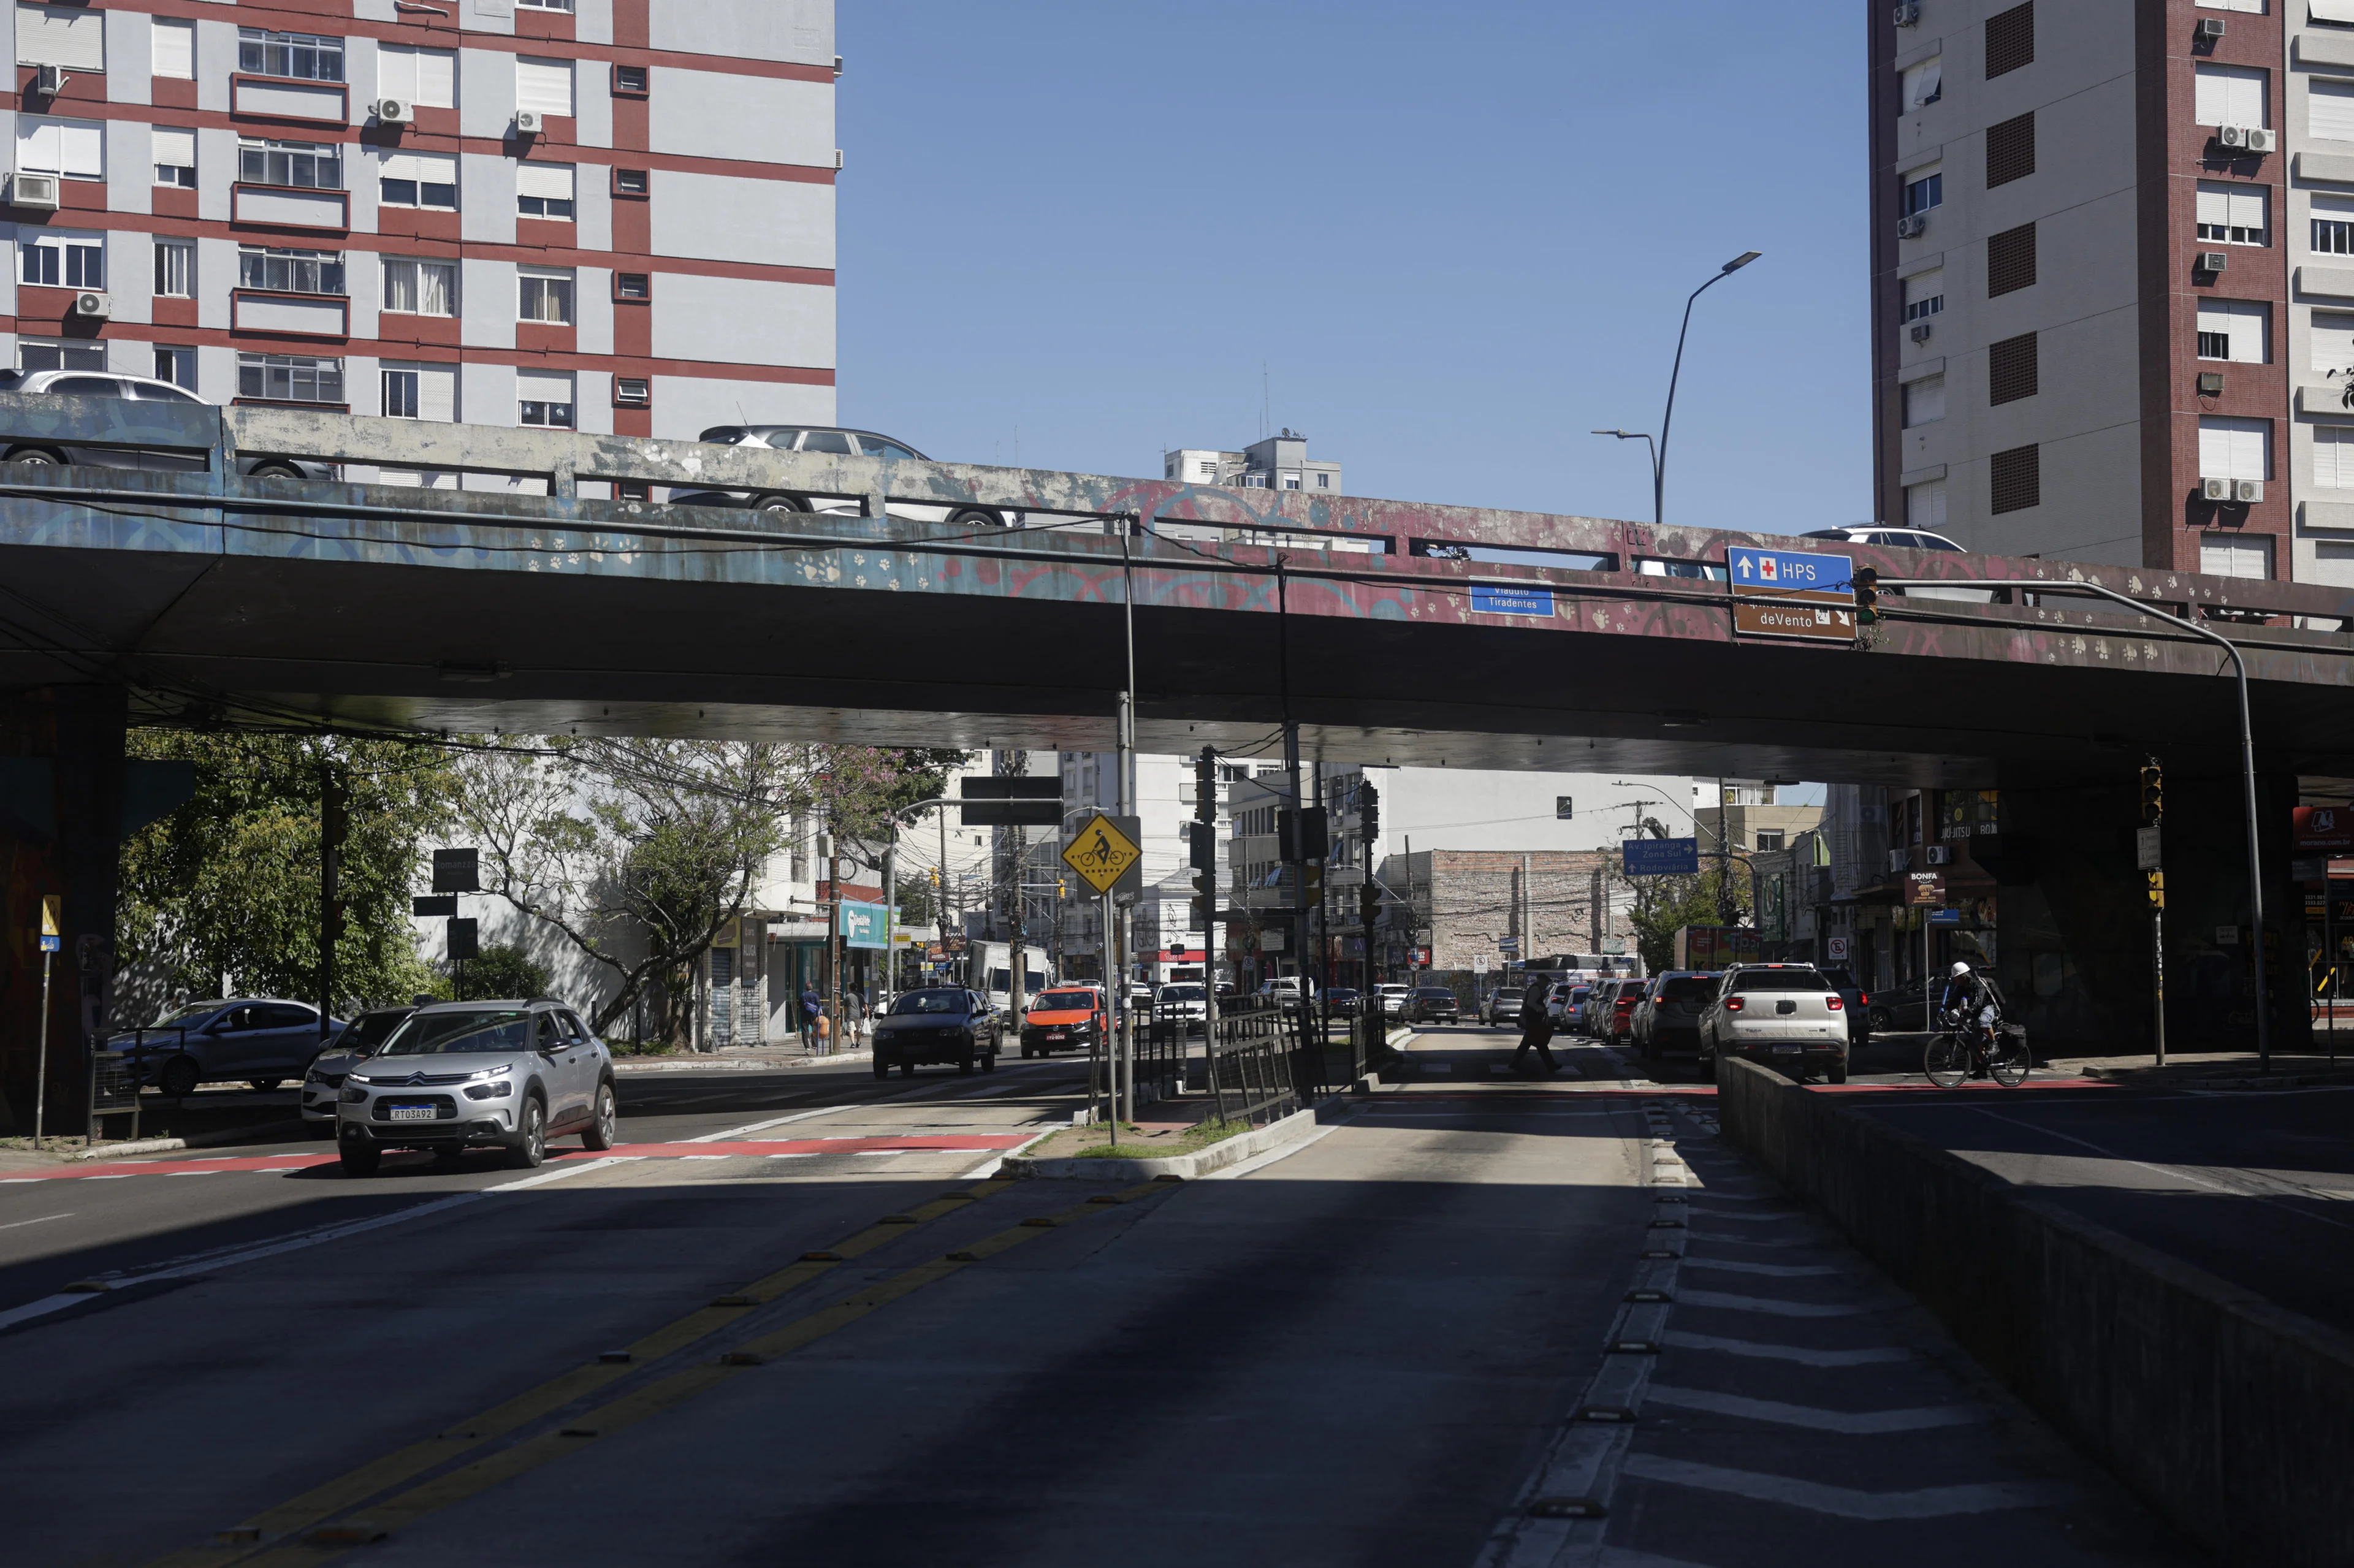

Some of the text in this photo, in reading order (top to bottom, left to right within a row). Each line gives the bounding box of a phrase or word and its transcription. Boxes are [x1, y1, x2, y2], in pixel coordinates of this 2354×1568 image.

[1783, 562, 1816, 580] HPS
[1488, 597, 1537, 609] Tiradentes
[1644, 842, 1681, 850] Ipiranga
[435, 860, 476, 870] Romanzza
